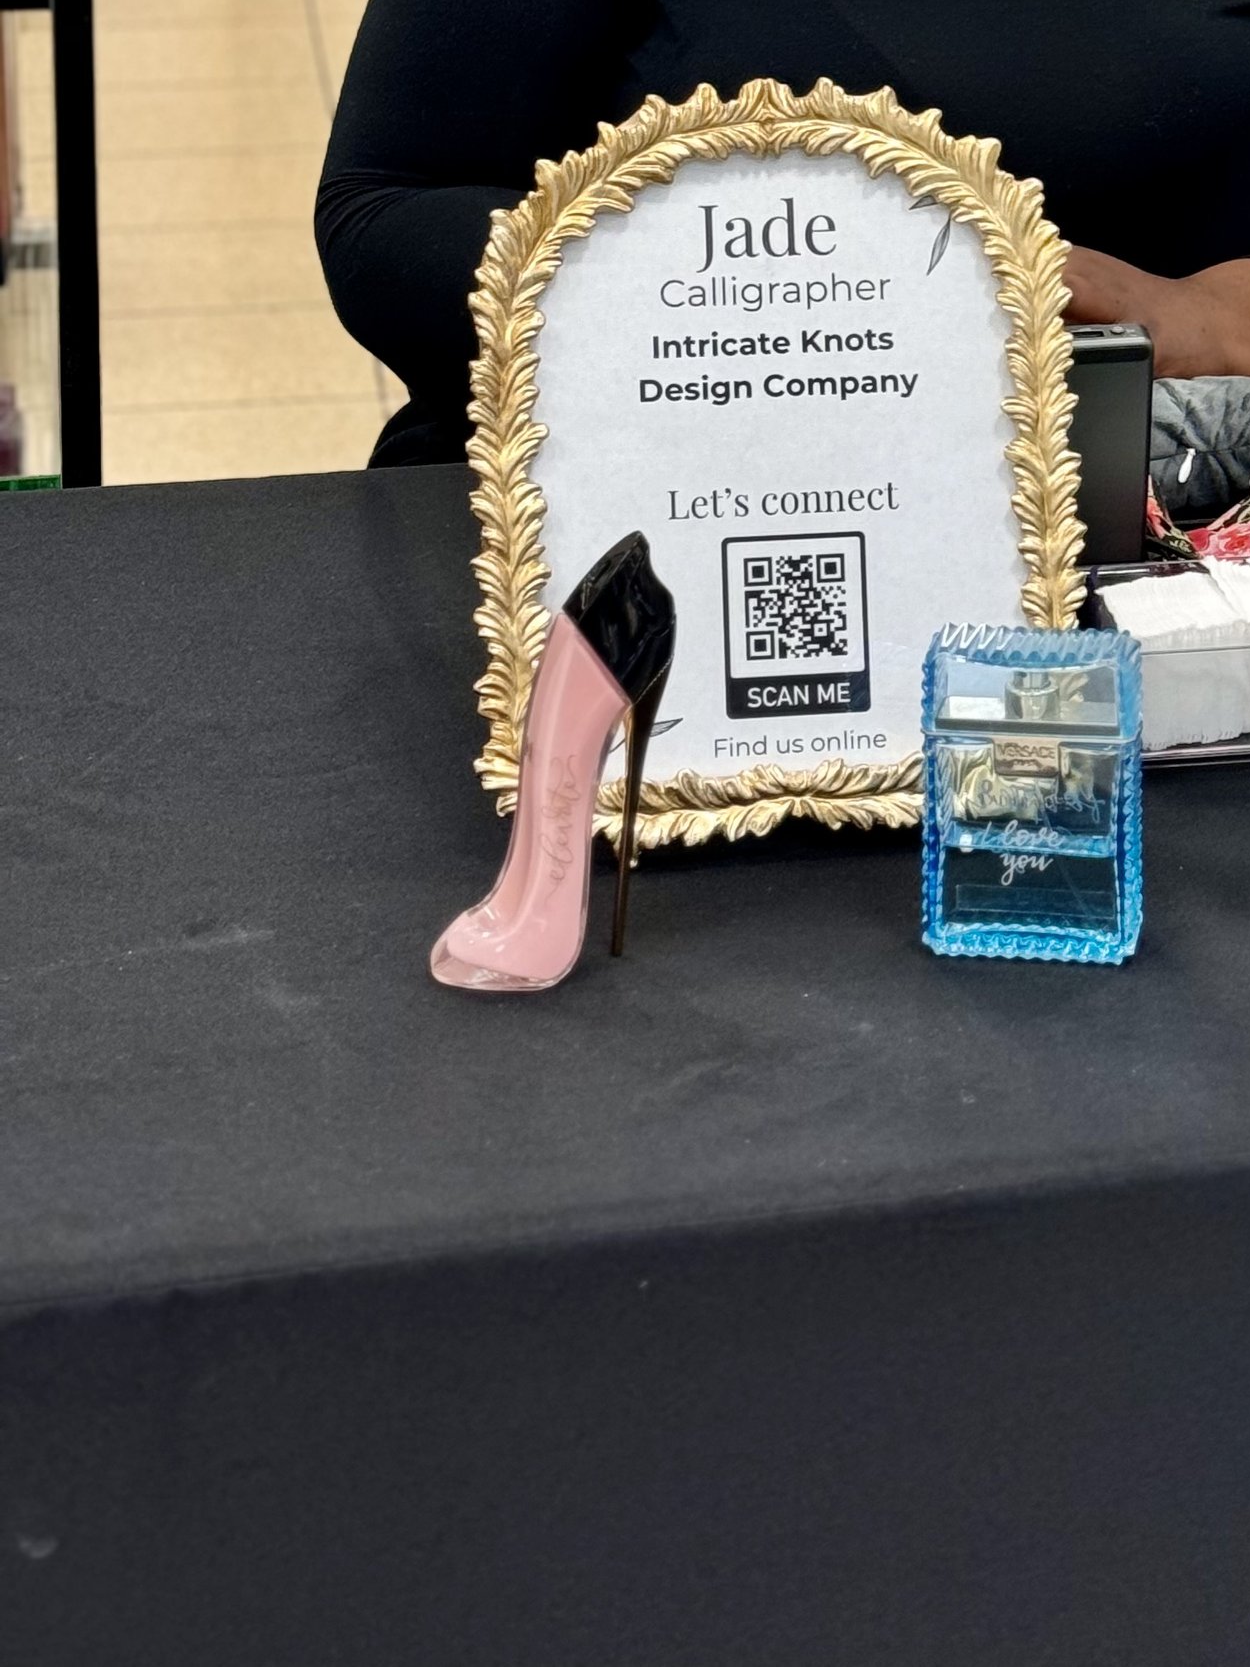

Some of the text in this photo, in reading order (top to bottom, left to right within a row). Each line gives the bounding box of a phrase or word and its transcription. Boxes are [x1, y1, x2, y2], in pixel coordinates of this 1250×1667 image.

[696, 197, 837, 274] Jade
[660, 272, 891, 313] Calligrapher
[652, 328, 894, 359] Intricate Knots
[639, 373, 919, 406] Design Company
[761, 482, 900, 516] connect
[747, 681, 851, 708] SCAN ME
[714, 729, 887, 759] Find us online
[1000, 819, 1065, 847] love
[999, 852, 1055, 886] you
